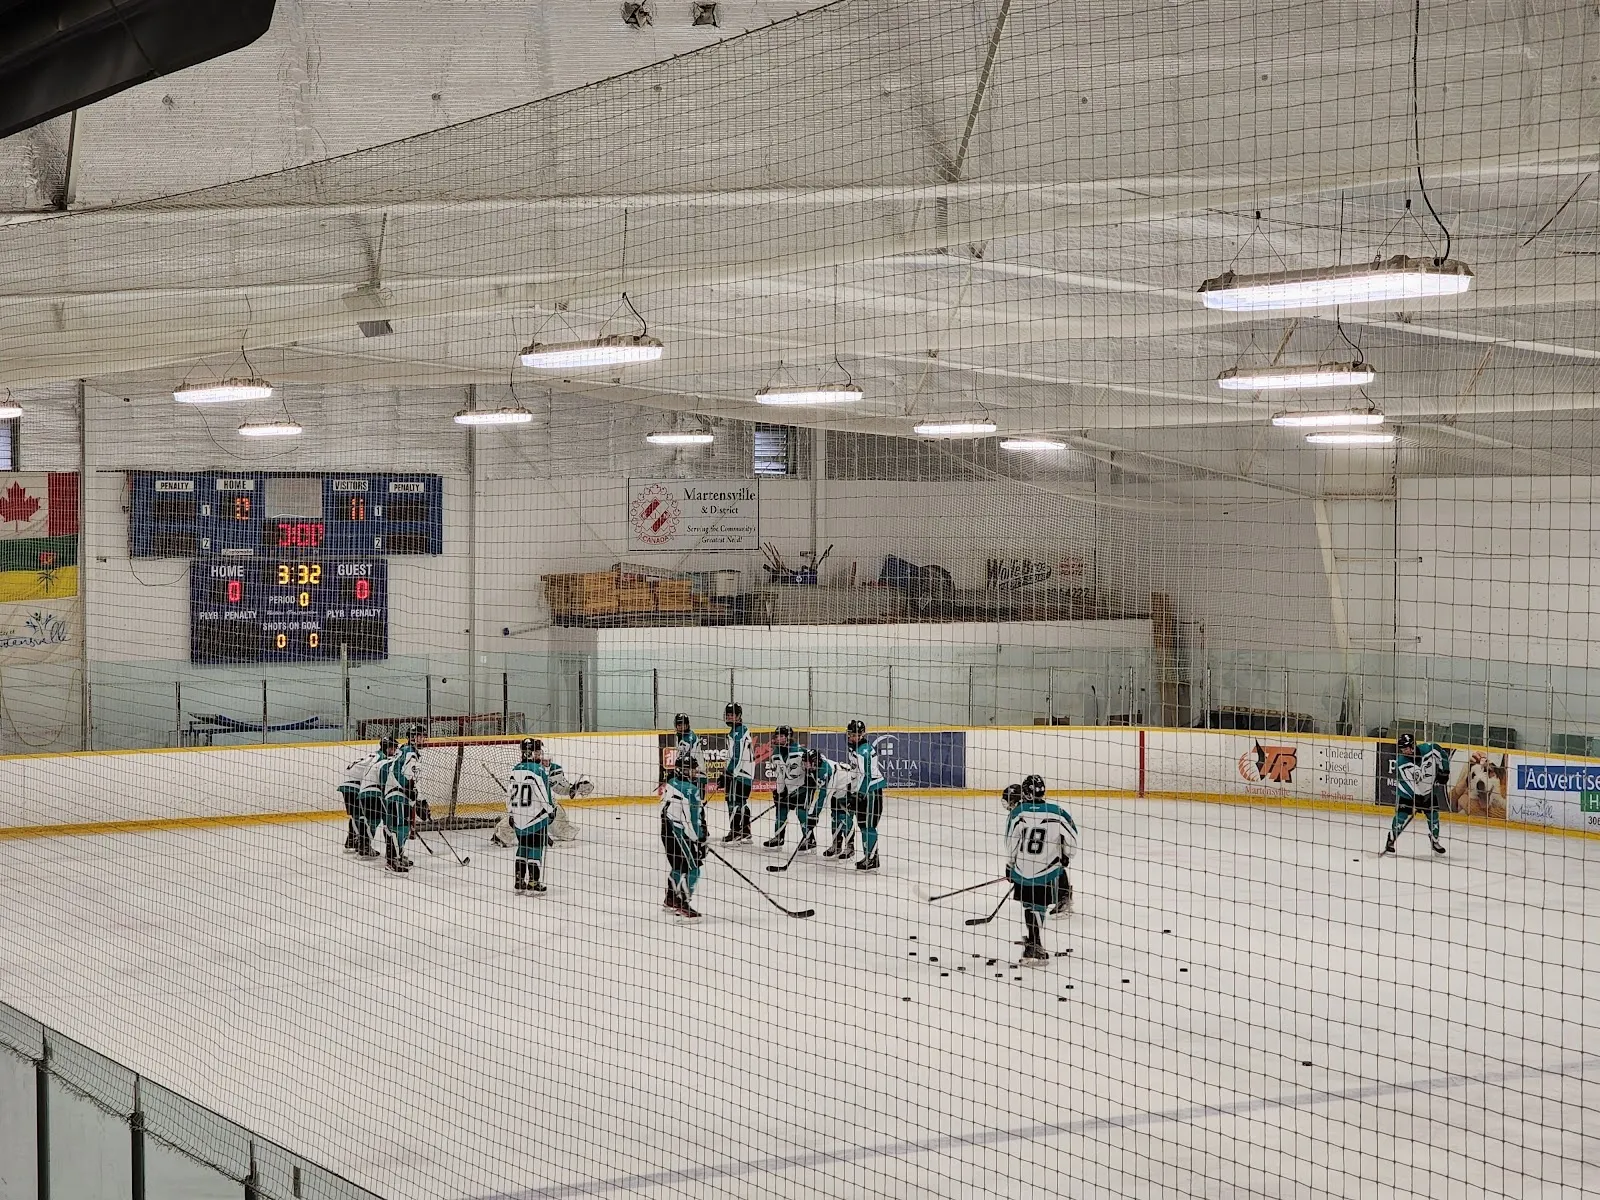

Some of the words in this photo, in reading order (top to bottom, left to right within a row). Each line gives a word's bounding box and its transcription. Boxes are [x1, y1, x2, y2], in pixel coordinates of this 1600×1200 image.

[160, 482, 189, 490] PENALTY
[223, 480, 247, 490] HOME
[335, 481, 367, 491] VISITORS
[393, 483, 420, 492] PENALTY
[684, 487, 756, 501] Martensville
[701, 506, 708, 514] &
[710, 505, 739, 514] District
[211, 565, 245, 578] HOME
[278, 564, 321, 585] 3:32
[338, 564, 373, 576] GUEST
[228, 580, 241, 603] 0
[356, 579, 369, 600] 0
[269, 596, 296, 604] PERIOD
[300, 591, 309, 607] 0
[200, 611, 219, 620] PLYR
[224, 610, 257, 620] PENALTY
[327, 609, 345, 618] PLYR
[351, 608, 381, 618] PENALTY
[262, 622, 287, 631] SHOTS
[288, 621, 300, 630] ON
[301, 621, 320, 630] GOAL
[277, 633, 287, 648] 0
[309, 633, 319, 648] 0
[1325, 747, 1363, 760] Unleaded
[878, 760, 918, 770] NALTA
[1325, 760, 1350, 772] Diesel
[1325, 774, 1359, 788] Propane
[1525, 767, 1600, 791] Advertise
[510, 784, 532, 807] 20
[1019, 826, 1047, 855] 18
